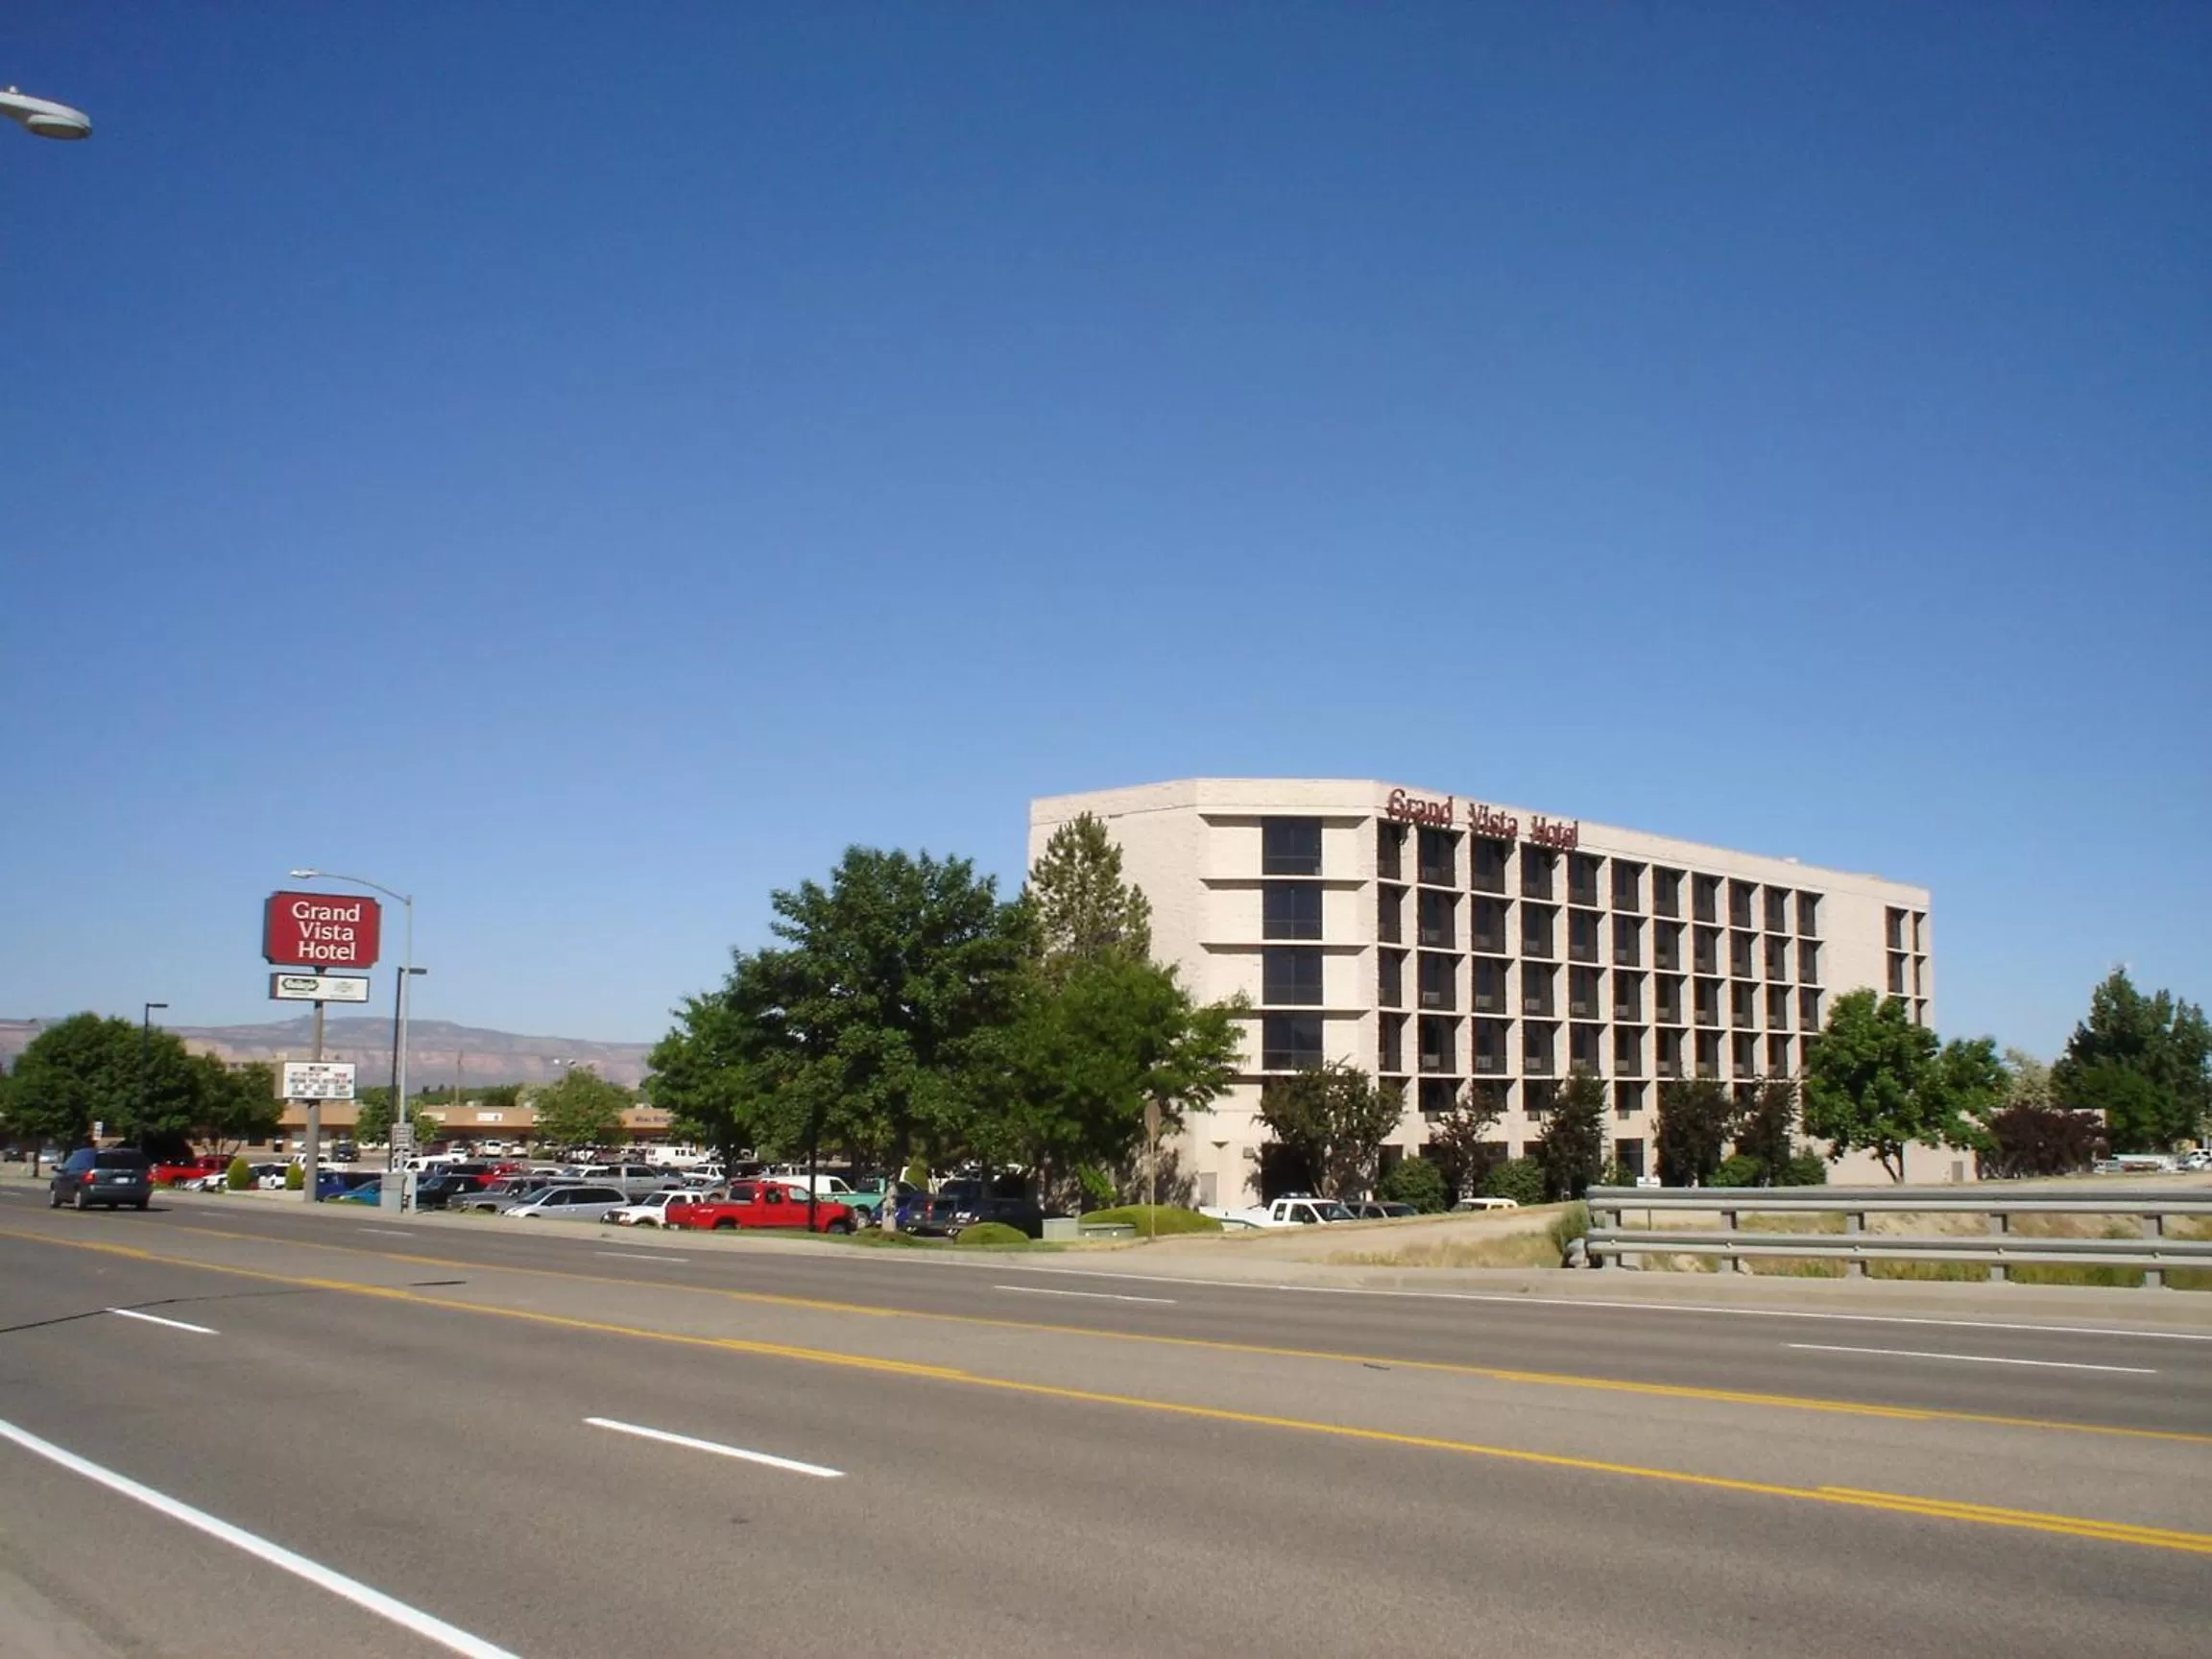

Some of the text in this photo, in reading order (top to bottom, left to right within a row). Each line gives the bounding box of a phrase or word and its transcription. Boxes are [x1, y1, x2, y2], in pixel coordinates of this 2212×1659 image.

[1385, 787, 1578, 849] Grand Vista Hotel
[291, 901, 360, 923] Grand
[299, 921, 354, 941] Vista
[298, 941, 356, 961] Hotel
